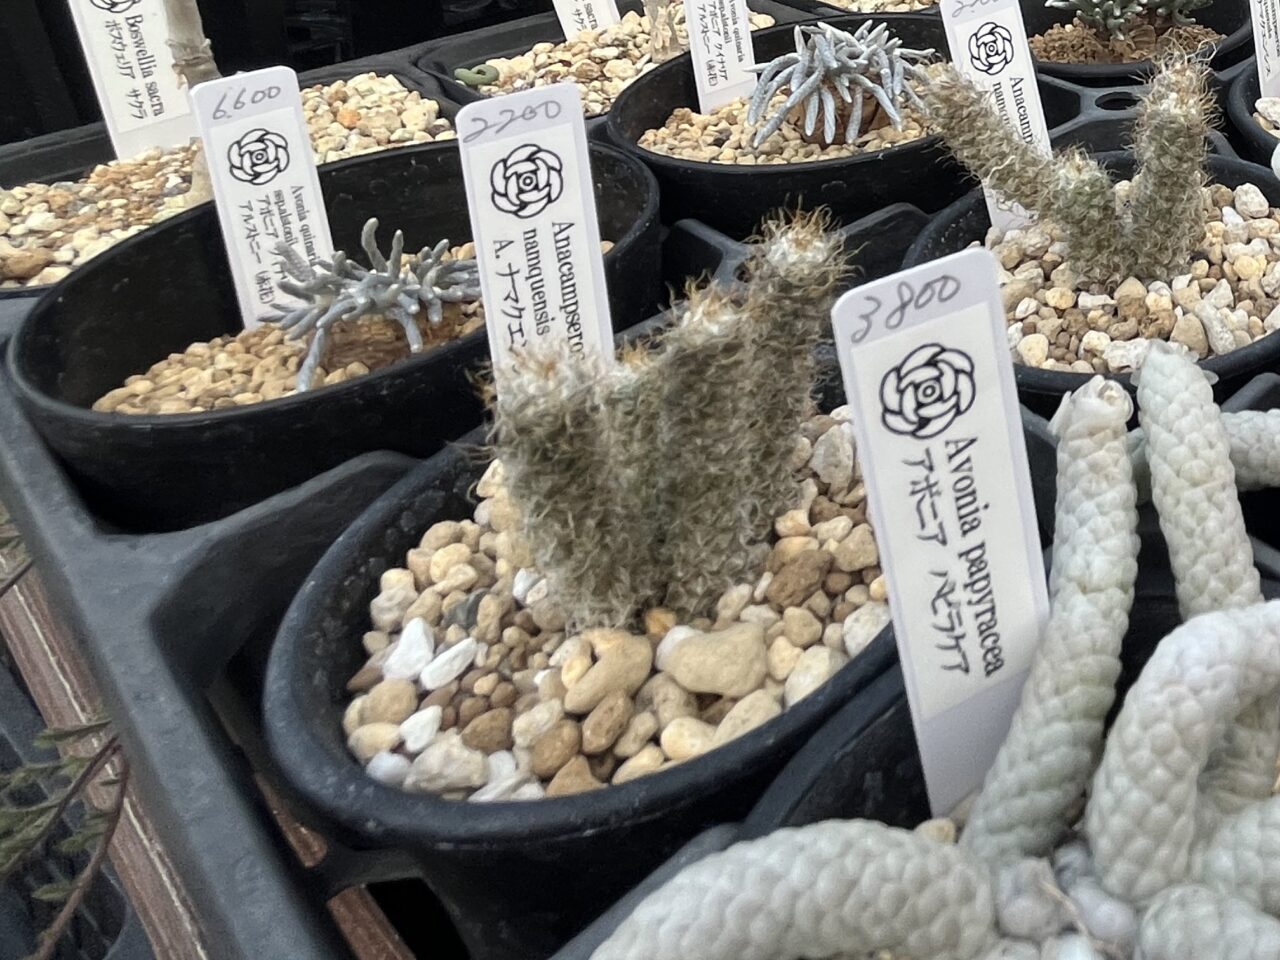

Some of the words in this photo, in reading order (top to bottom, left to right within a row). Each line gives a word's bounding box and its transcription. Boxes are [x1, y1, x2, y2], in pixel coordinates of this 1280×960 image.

[583, 2, 599, 31] sacra
[125, 14, 159, 79] Boswellia
[145, 81, 166, 117] sacra
[127, 88, 148, 120] サクラ
[290, 185, 309, 222] Avonia
[523, 227, 556, 337] namquensis
[850, 274, 961, 343] 3800
[944, 436, 990, 538] Avonia
[957, 540, 1006, 678] papyracea
